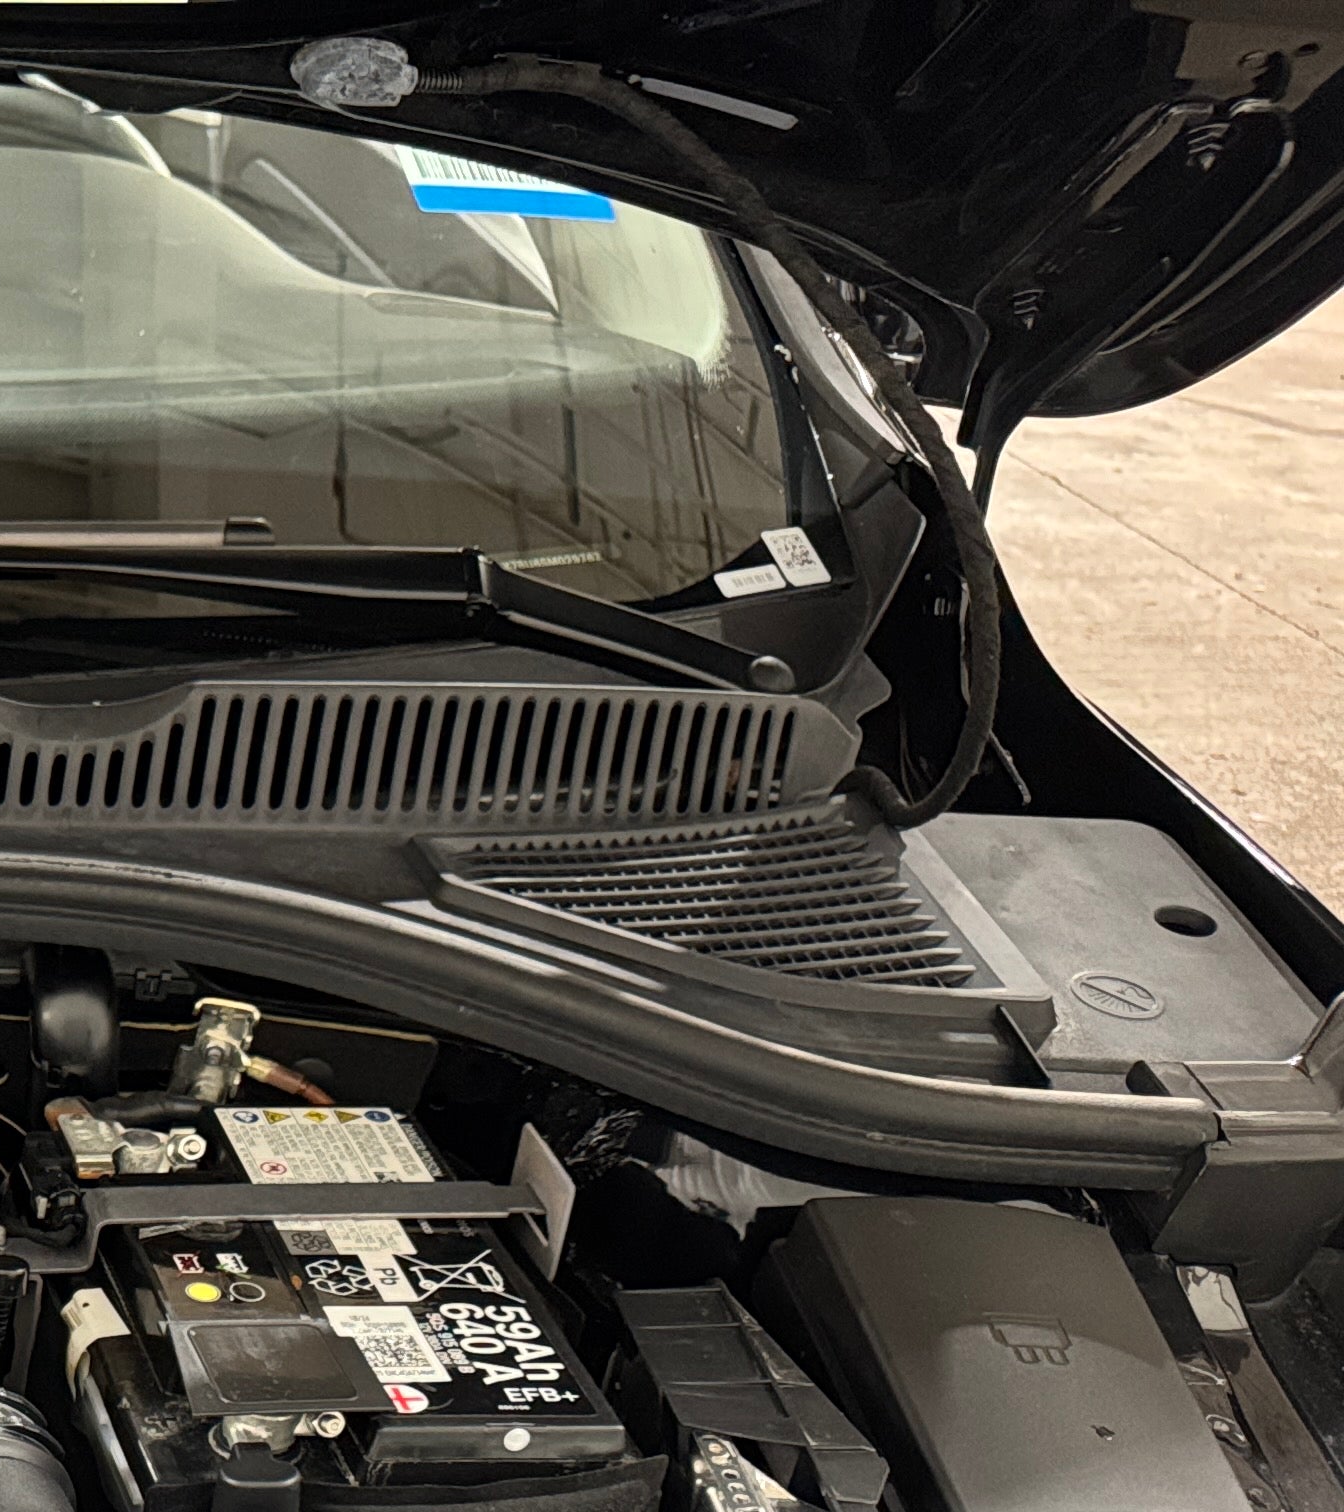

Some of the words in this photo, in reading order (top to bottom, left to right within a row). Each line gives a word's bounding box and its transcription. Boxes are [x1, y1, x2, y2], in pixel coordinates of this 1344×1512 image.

[373, 1267, 397, 1287] Pb
[439, 1302, 507, 1355] 640
[473, 1361, 525, 1386] A
[484, 1304, 566, 1382] 59Ah
[503, 1386, 581, 1403] EFB+
